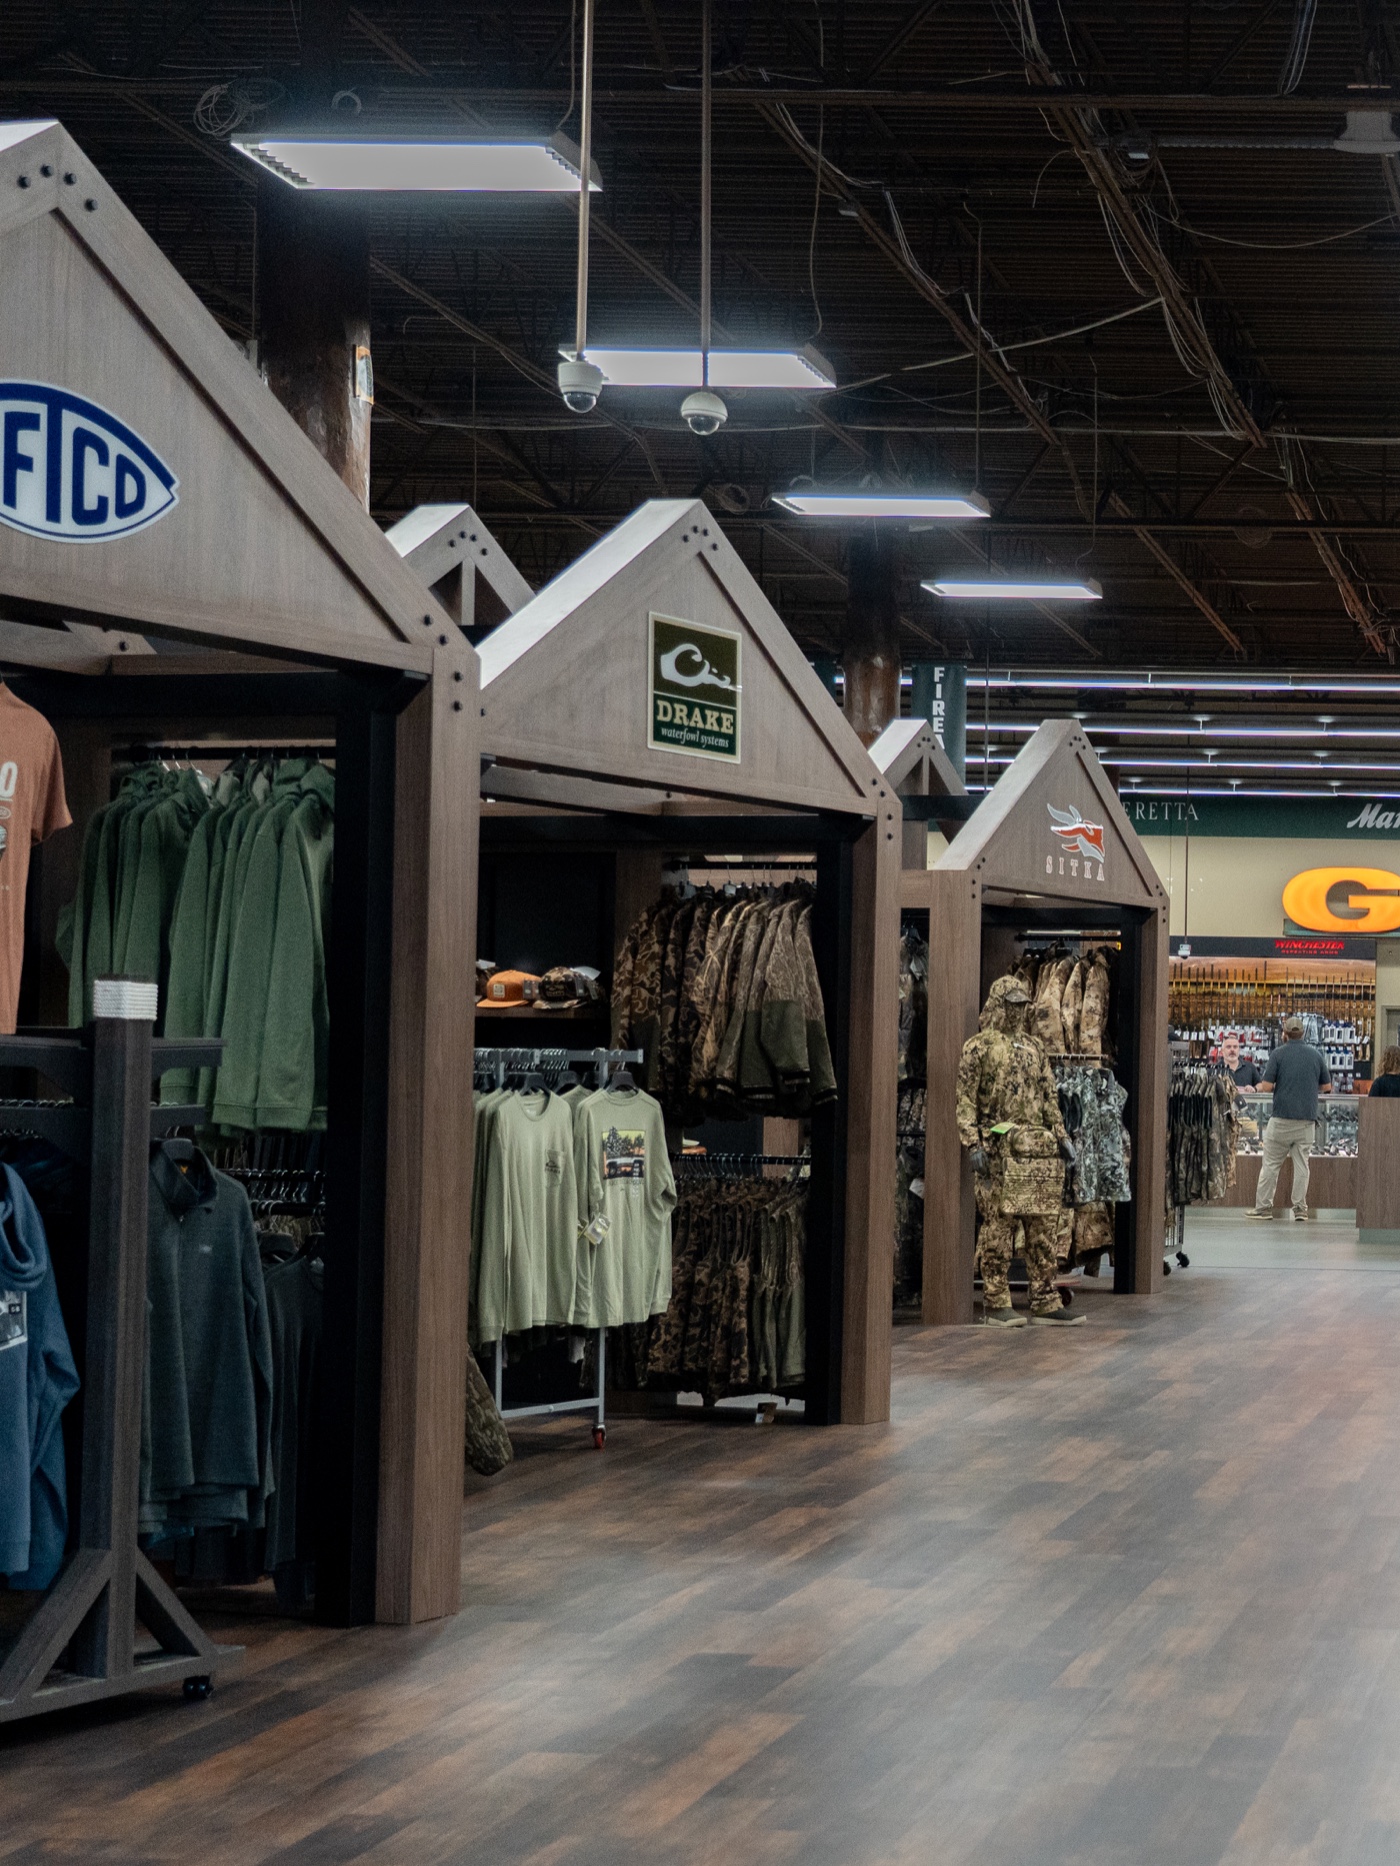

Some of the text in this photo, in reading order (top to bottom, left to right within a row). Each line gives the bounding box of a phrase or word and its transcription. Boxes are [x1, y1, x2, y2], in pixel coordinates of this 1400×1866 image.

[657, 700, 733, 734] DRAKE
[661, 726, 729, 749] waterfowl systems
[1046, 855, 1105, 882] SITKA
[1274, 939, 1345, 950] WINCHESTER
